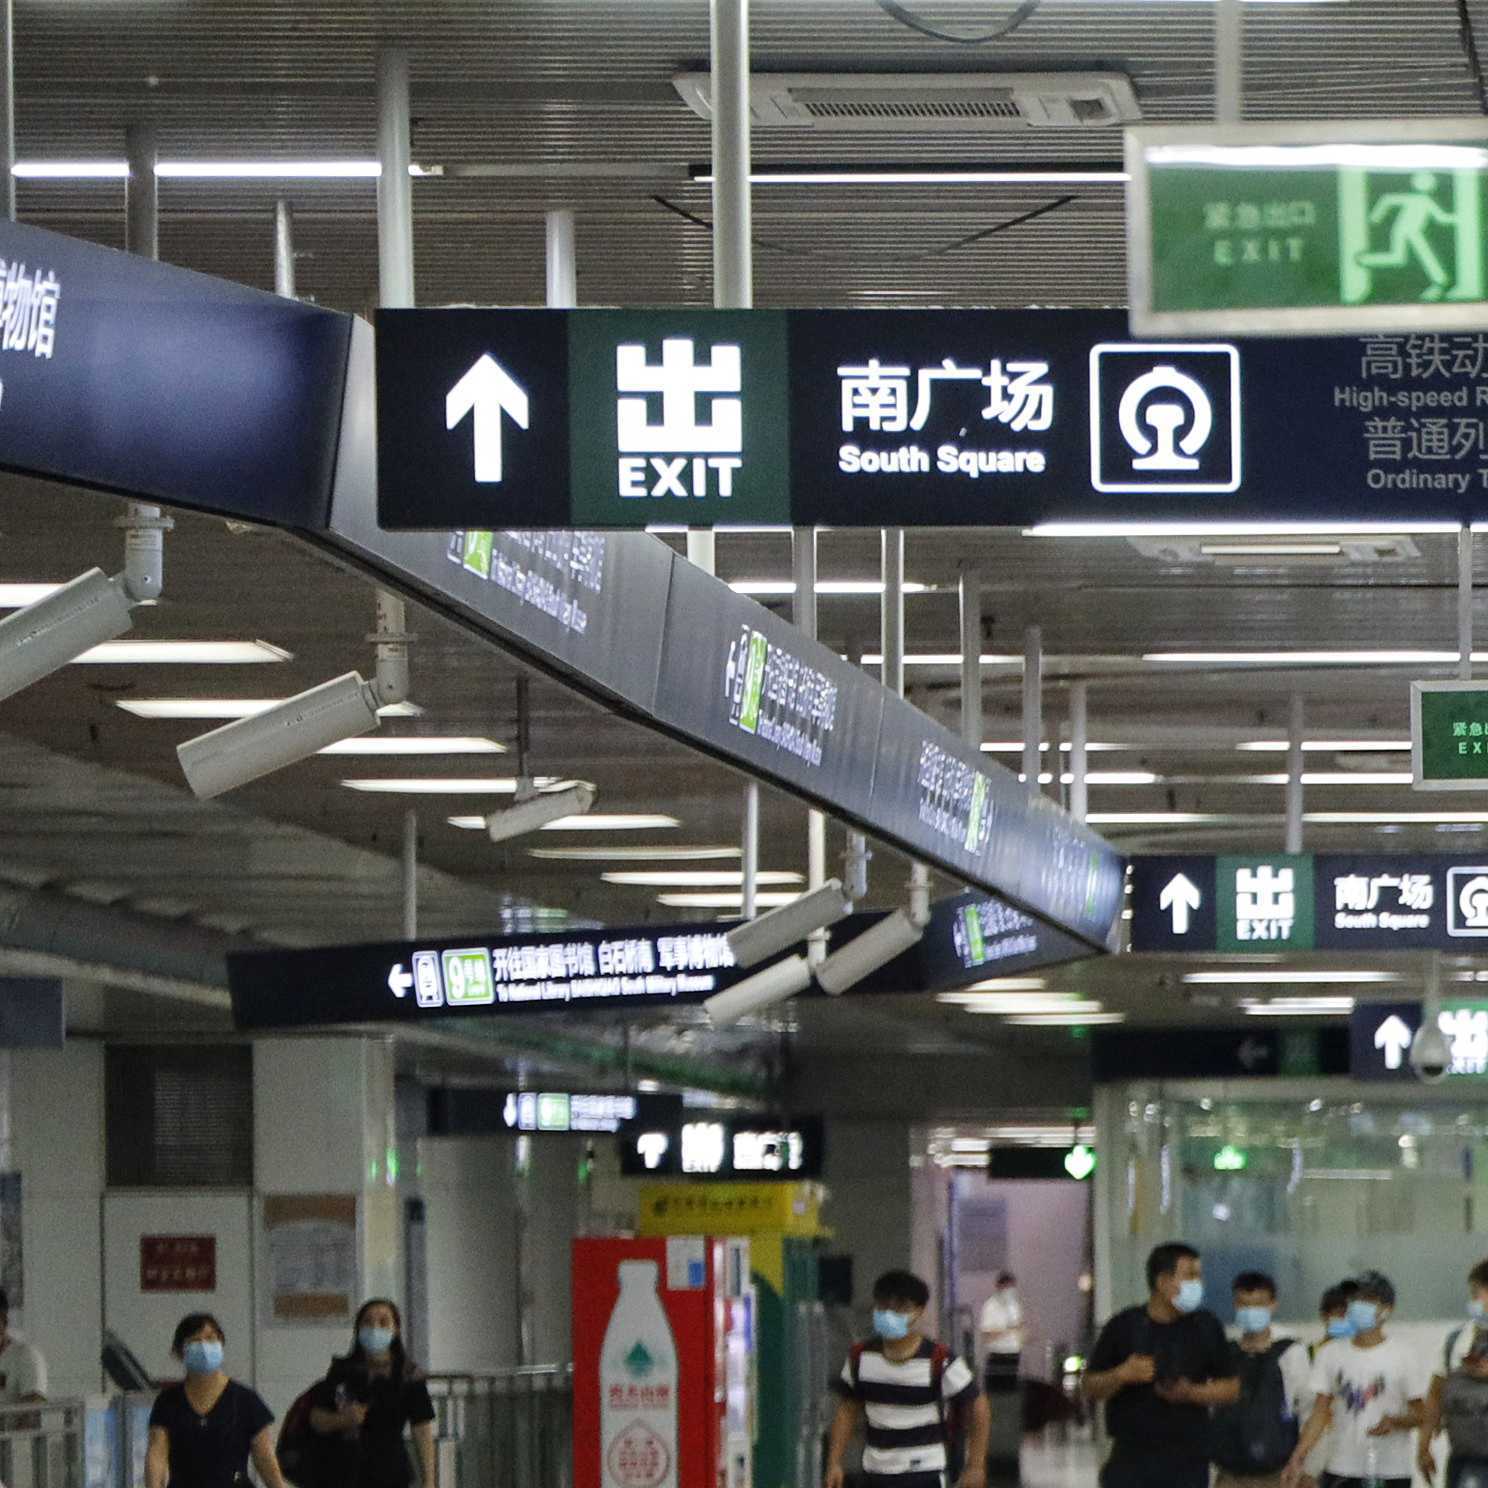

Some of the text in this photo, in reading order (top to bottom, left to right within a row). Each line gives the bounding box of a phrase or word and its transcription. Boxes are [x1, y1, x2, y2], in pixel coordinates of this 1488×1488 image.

[1214, 238, 1305, 265] EXIT
[616, 338, 743, 452] 出
[836, 357, 1056, 432] 南广场
[1333, 385, 1469, 412] High-speed
[618, 457, 743, 497] EXIT
[838, 444, 1047, 479] South Square
[1366, 468, 1470, 493] Ordinary
[1236, 865, 1294, 919] 出
[1334, 873, 1433, 910] 南广场
[1236, 919, 1294, 940] EXIT
[1335, 911, 1430, 930] South Square
